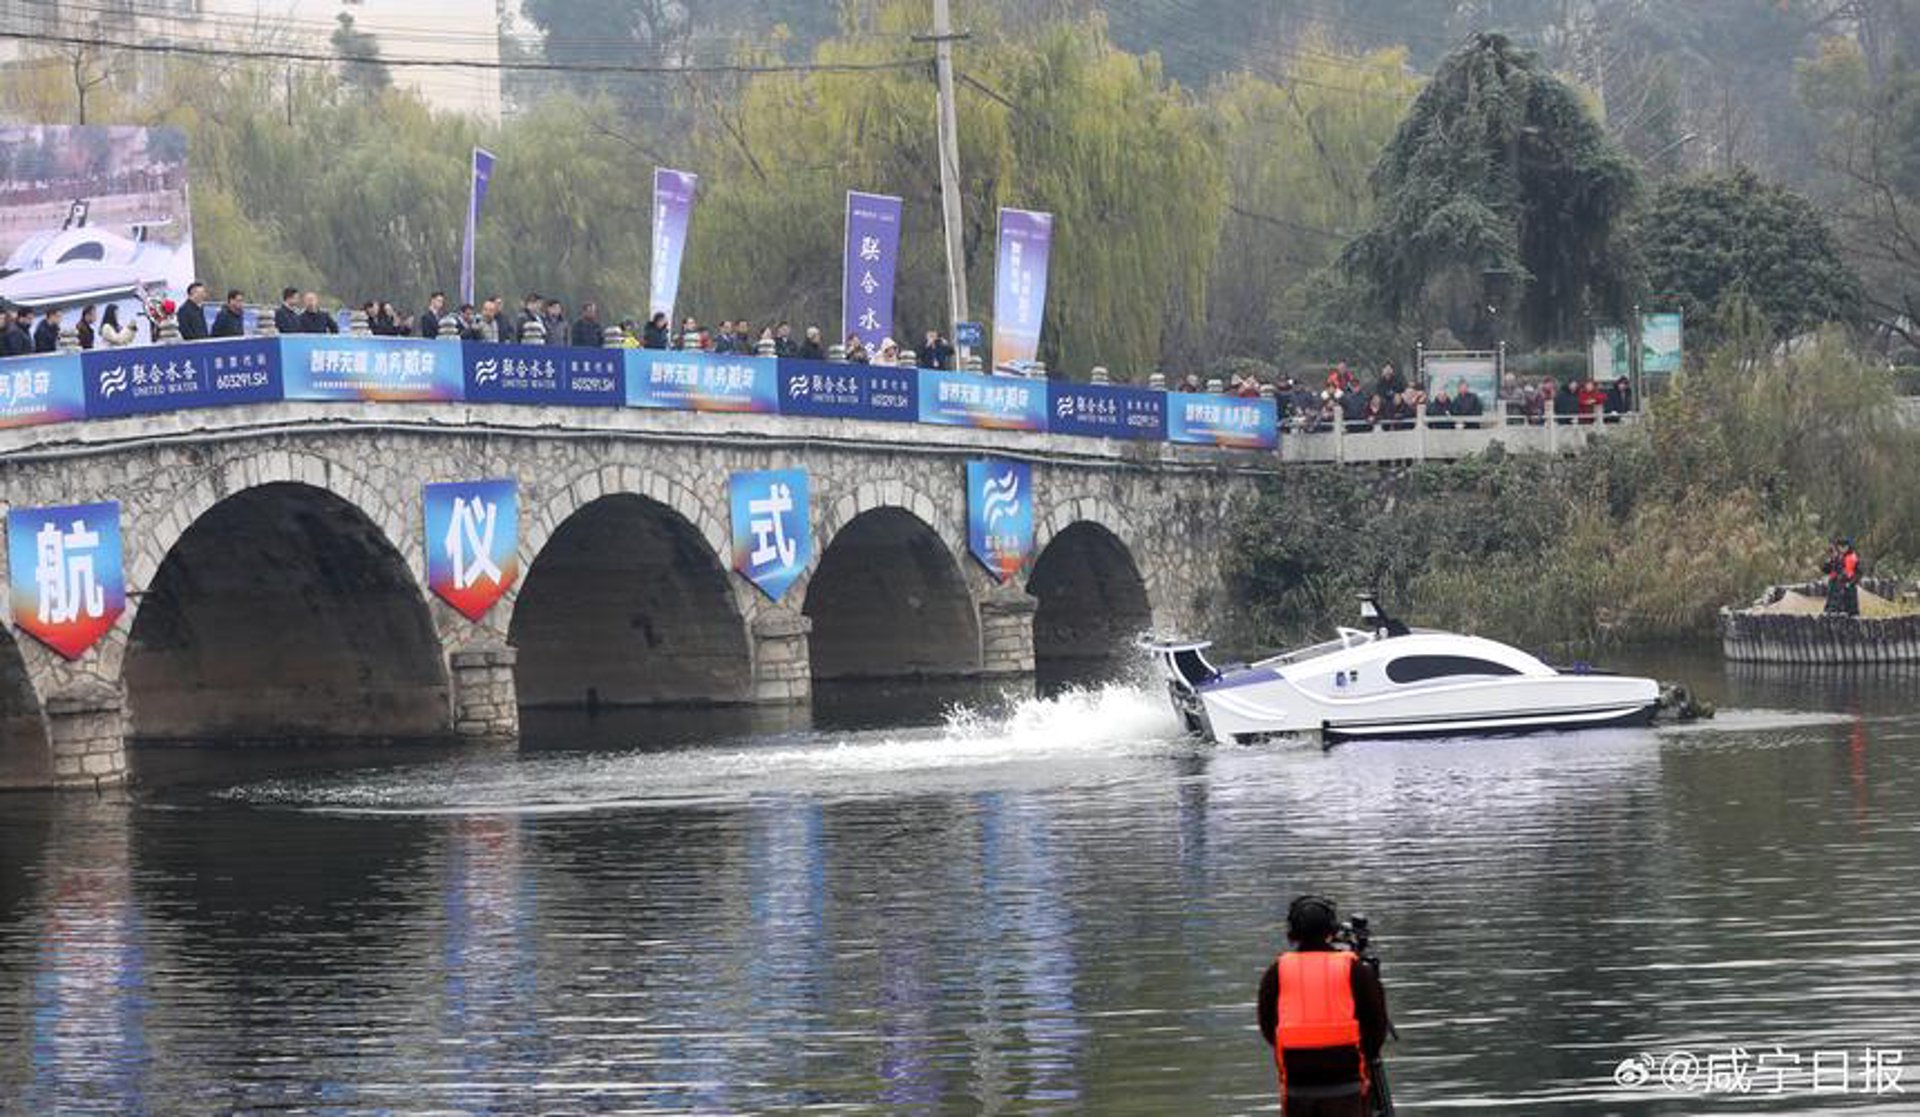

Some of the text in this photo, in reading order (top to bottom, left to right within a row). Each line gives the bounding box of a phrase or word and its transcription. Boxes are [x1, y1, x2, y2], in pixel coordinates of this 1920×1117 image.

[132, 360, 197, 384] 联合水务
[216, 372, 268, 389] 603291.SH
[502, 359, 555, 378] 联合水务
[133, 381, 198, 396] UNITED WATER
[749, 483, 796, 569] 式
[445, 496, 501, 588] 仪
[36, 520, 104, 624] 航
